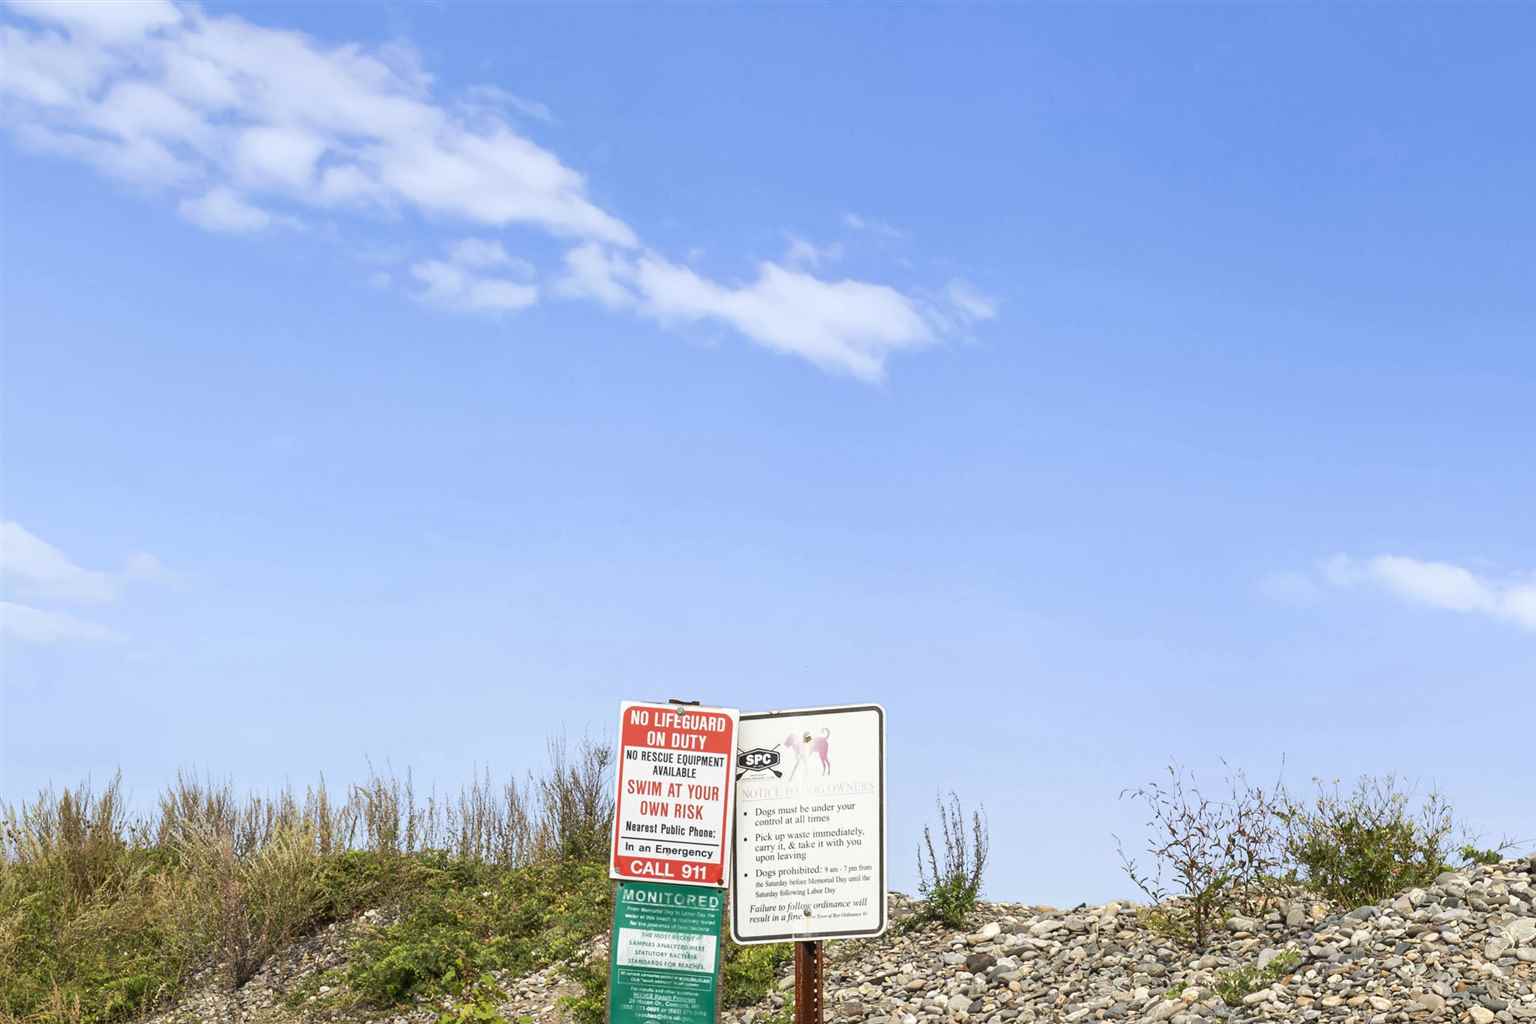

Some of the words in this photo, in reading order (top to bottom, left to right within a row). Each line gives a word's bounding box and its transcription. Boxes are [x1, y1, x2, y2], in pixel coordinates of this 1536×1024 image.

[631, 710, 648, 726] NO
[654, 712, 726, 732] LIFEGUARD
[647, 732, 665, 747] ON
[672, 733, 707, 749] DUTY
[626, 750, 638, 760] NO
[641, 751, 673, 764] RESCUE
[677, 753, 725, 767] EQUIPMENT
[746, 754, 771, 766] SPC
[653, 765, 697, 778] AVAILABLE
[628, 779, 662, 797] SWIM
[668, 782, 683, 798] AT
[688, 784, 719, 800] YOUR
[640, 801, 669, 817] OWN
[674, 804, 703, 820] RISK
[755, 807, 776, 818] Dogs
[778, 806, 797, 814] must
[800, 804, 809, 813] be
[811, 803, 834, 812] under
[837, 802, 856, 811] your
[754, 817, 783, 826] control
[795, 814, 805, 823] all
[808, 814, 830, 822] times
[626, 821, 658, 833] Nearest
[661, 824, 686, 836] Public
[755, 833, 772, 842] Pick
[775, 833, 785, 842] up
[787, 831, 810, 839] waste
[625, 842, 634, 851] In
[639, 844, 652, 853] an
[656, 844, 713, 859] Emergency
[754, 843, 775, 854] carry
[798, 840, 816, 848] take
[826, 838, 844, 847] with
[846, 839, 862, 848] you
[755, 854, 774, 863] upon
[777, 851, 806, 861] leaving
[630, 860, 674, 877] CALL
[682, 864, 707, 879] 911
[755, 869, 776, 879] Dogs
[623, 889, 719, 908] MONITORED
[755, 889, 778, 898] Saturday
[807, 886, 823, 895] Labor
[824, 886, 836, 894] Day
[750, 903, 776, 913] Failure
[778, 903, 786, 911] to
[813, 899, 850, 909] ordinance
[853, 898, 868, 907] will
[750, 913, 770, 923] result
[772, 912, 779, 921] in
